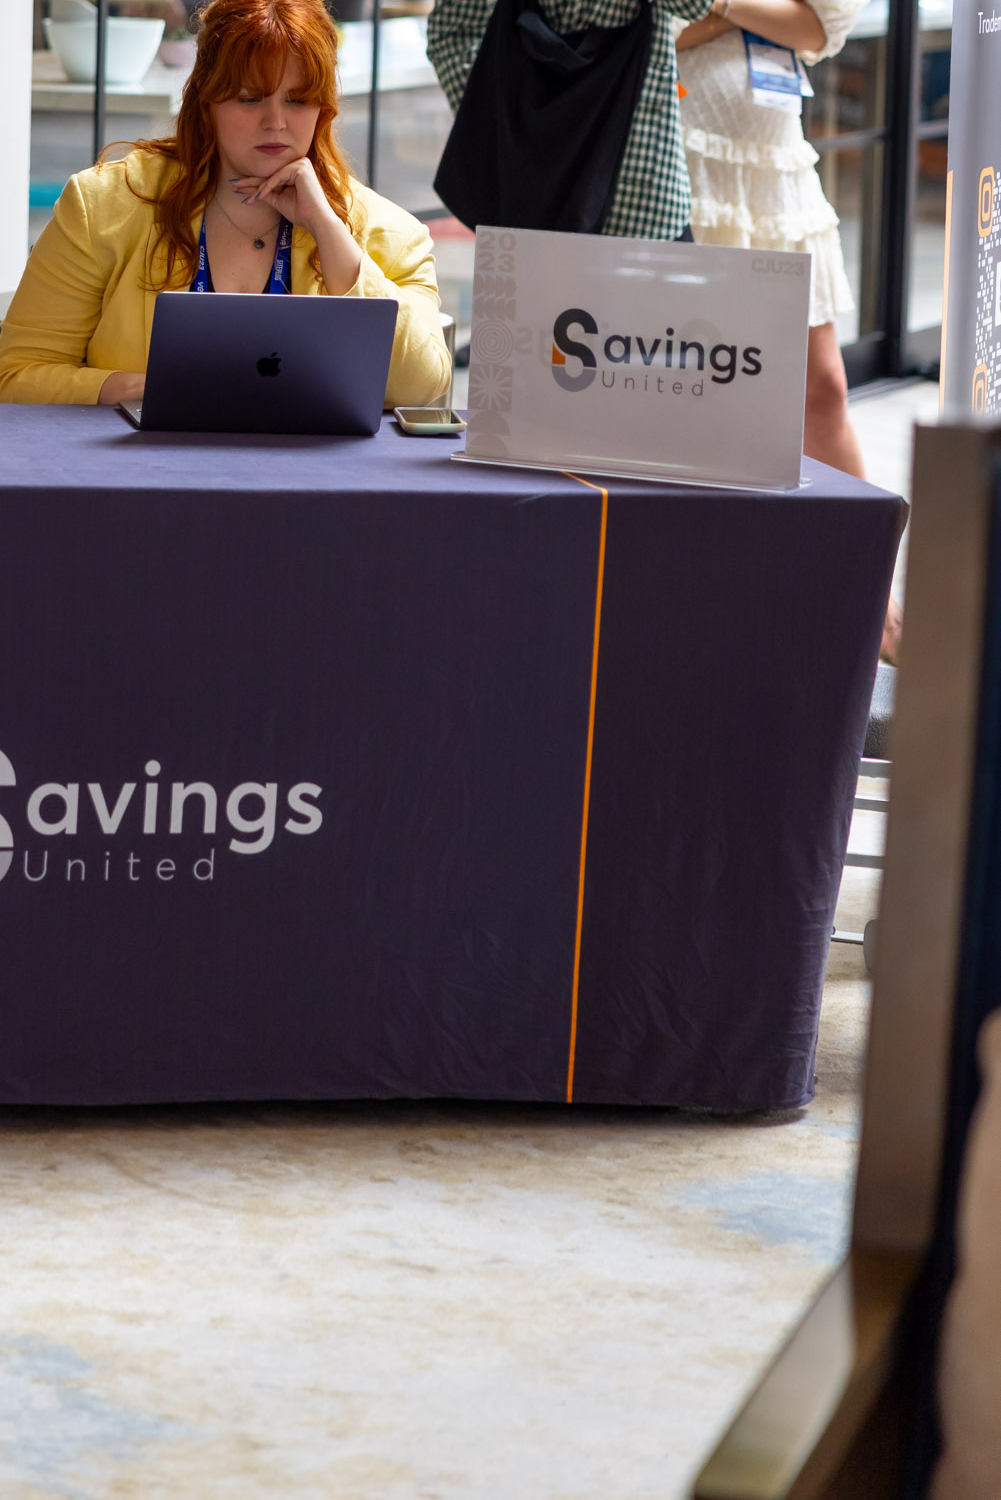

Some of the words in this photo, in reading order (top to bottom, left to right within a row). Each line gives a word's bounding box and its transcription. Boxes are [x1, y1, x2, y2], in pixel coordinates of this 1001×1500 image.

[478, 231, 517, 252] 20
[477, 251, 516, 273] 23
[751, 258, 805, 277] CJU23
[552, 308, 763, 393] Savings
[600, 370, 705, 398] United
[23, 848, 215, 883] United
